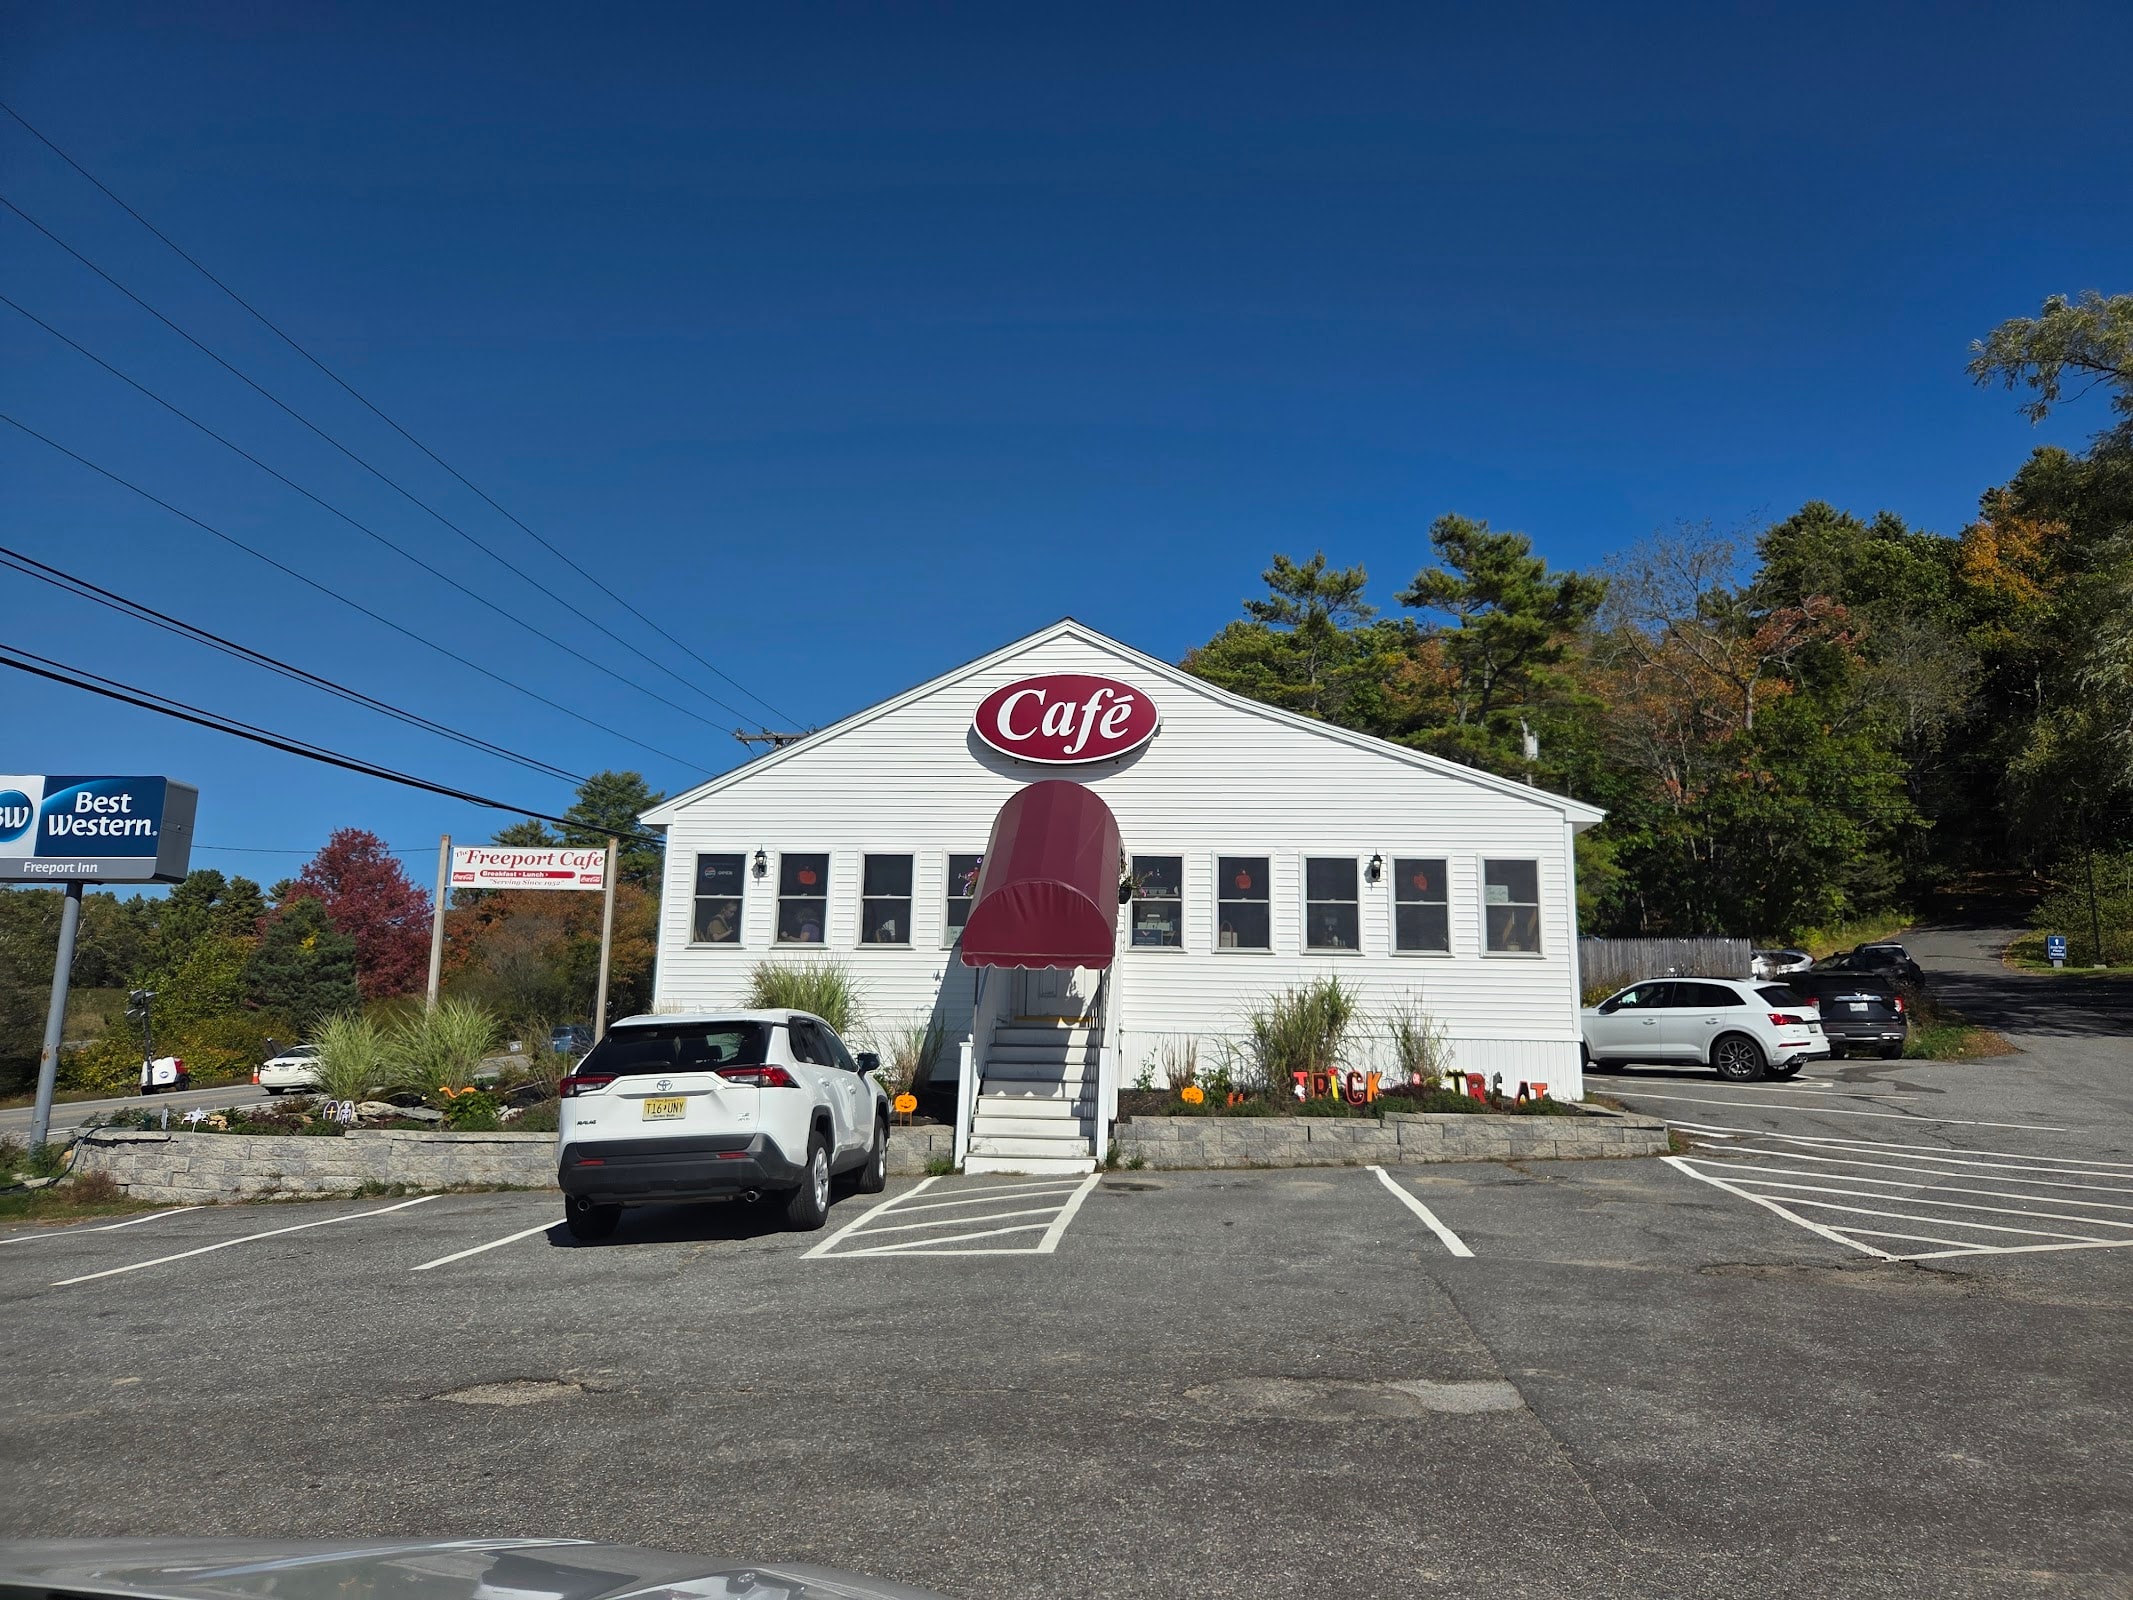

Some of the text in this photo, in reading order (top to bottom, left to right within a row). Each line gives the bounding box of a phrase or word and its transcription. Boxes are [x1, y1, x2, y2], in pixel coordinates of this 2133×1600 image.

[997, 687, 1135, 755] Café
[75, 791, 132, 814] Best
[0, 806, 30, 829] W
[23, 861, 98, 875] Freeport Inn
[466, 850, 556, 868] Freeport
[559, 851, 604, 870] Cafe
[482, 870, 517, 878] Breakfast
[1292, 1066, 1384, 1105] TRICK
